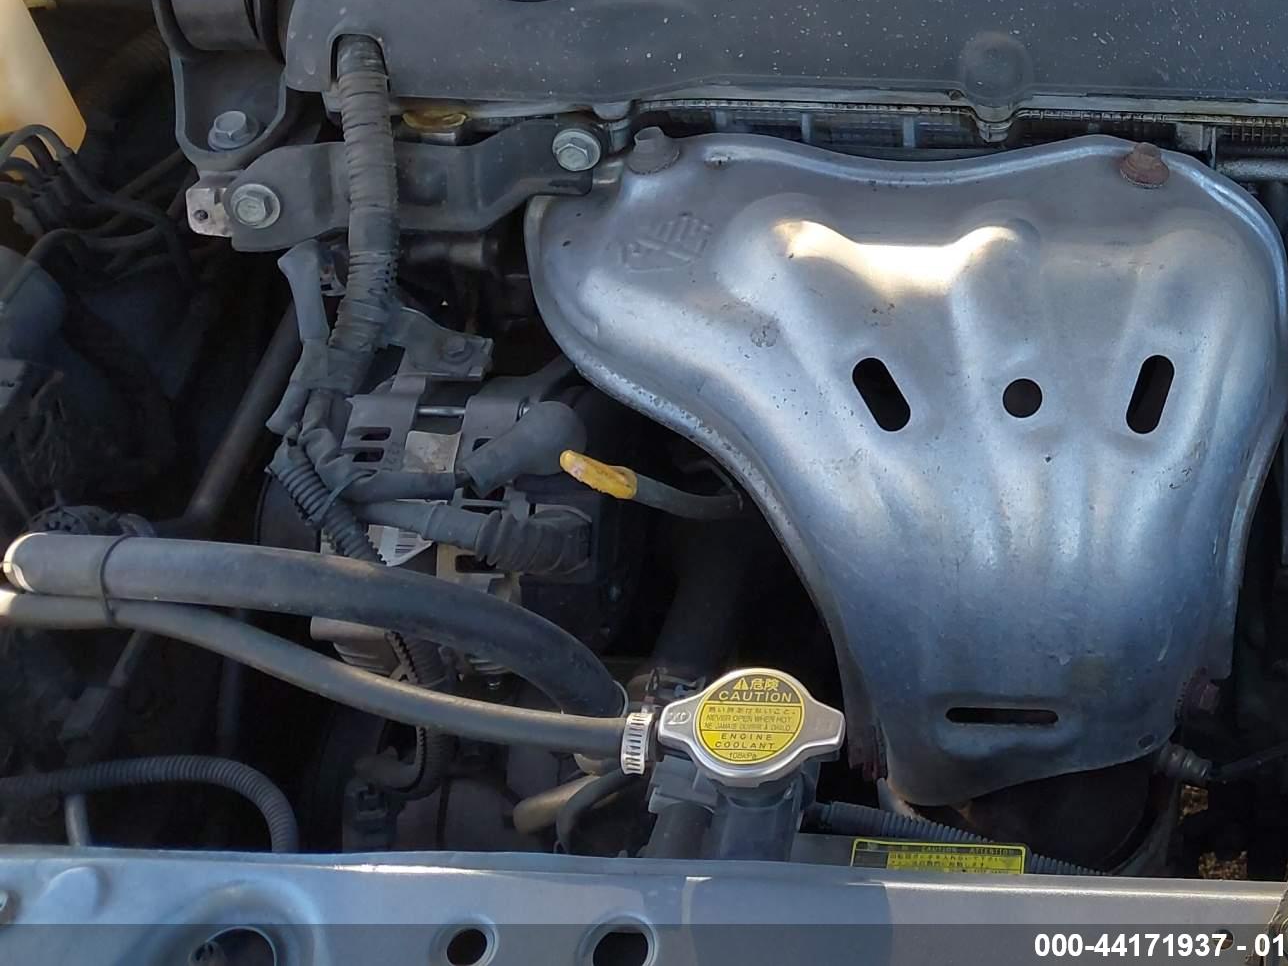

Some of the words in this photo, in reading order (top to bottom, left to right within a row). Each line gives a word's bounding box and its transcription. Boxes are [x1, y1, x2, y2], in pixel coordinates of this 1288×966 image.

[718, 690, 792, 703] CAUTION
[720, 732, 774, 741] ENGINE
[714, 741, 776, 750] COOLANT
